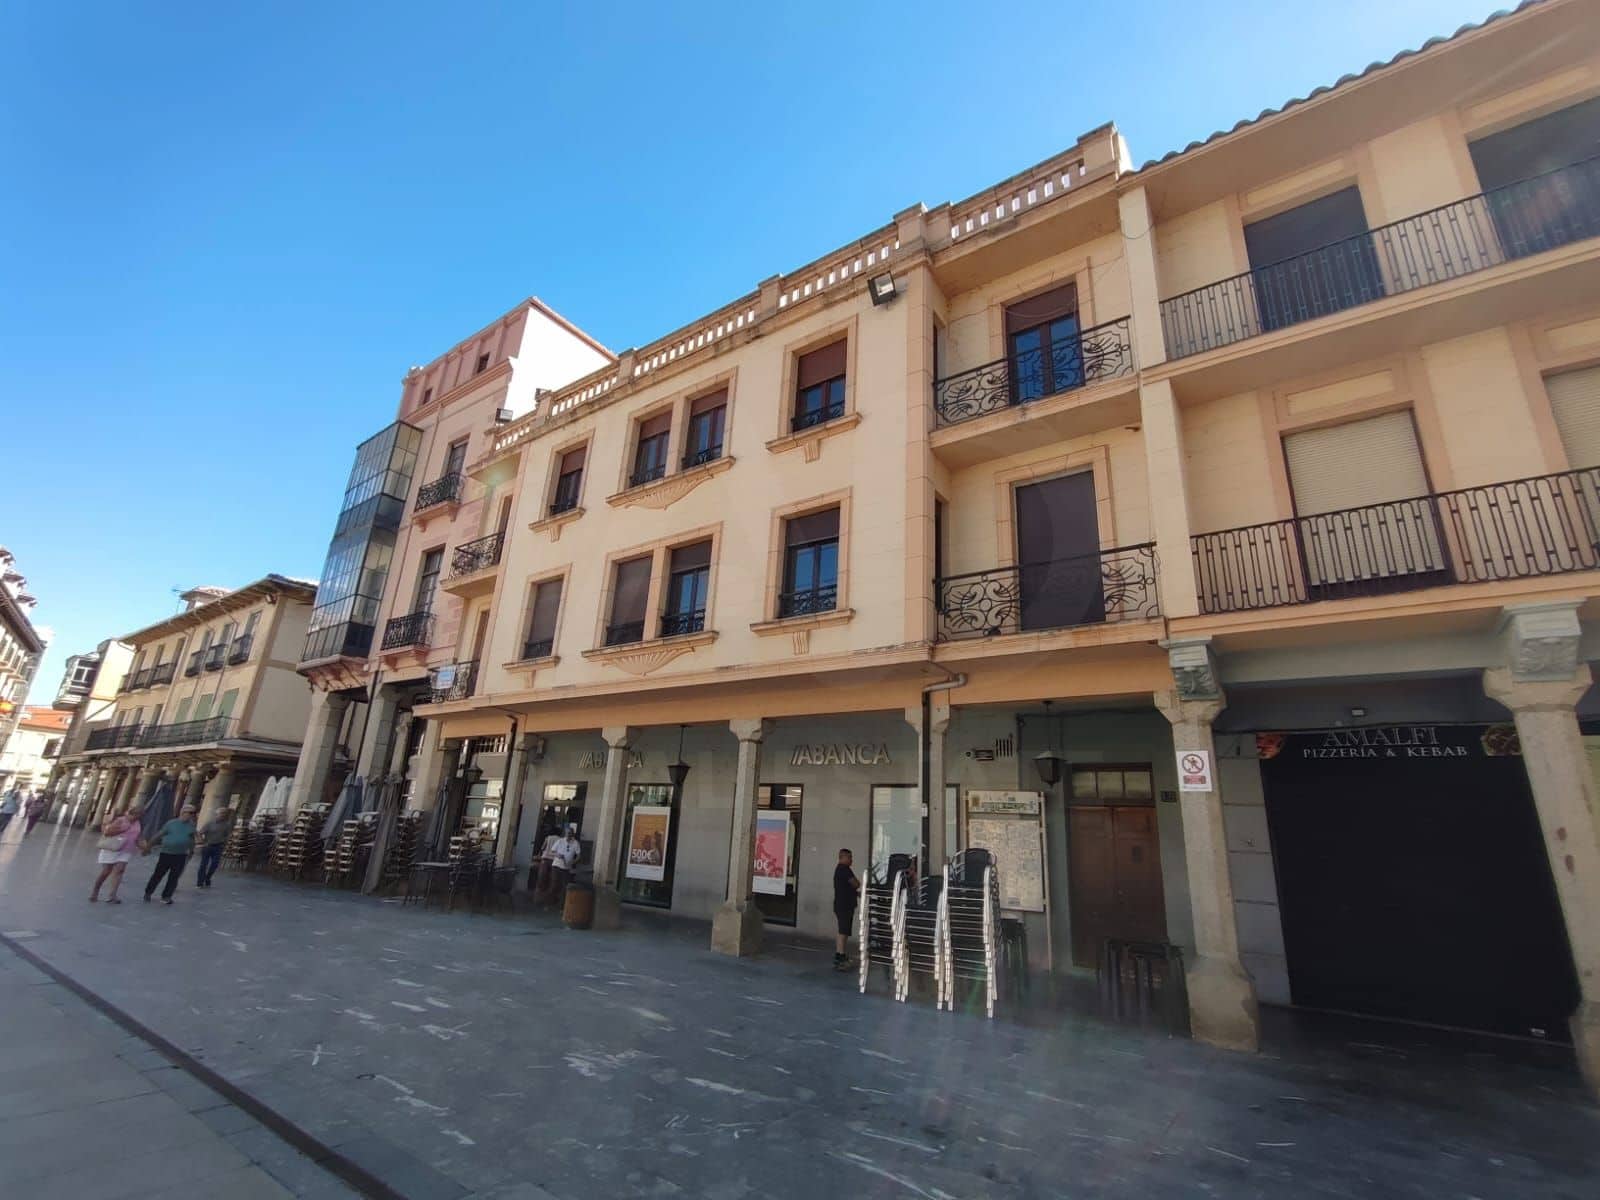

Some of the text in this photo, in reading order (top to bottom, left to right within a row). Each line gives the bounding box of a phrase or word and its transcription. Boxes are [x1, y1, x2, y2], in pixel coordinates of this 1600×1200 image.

[1323, 727, 1440, 746] AMALFI
[793, 744, 890, 765] ABANCA
[1386, 748, 1397, 758] &
[1407, 746, 1468, 758] KEBAB
